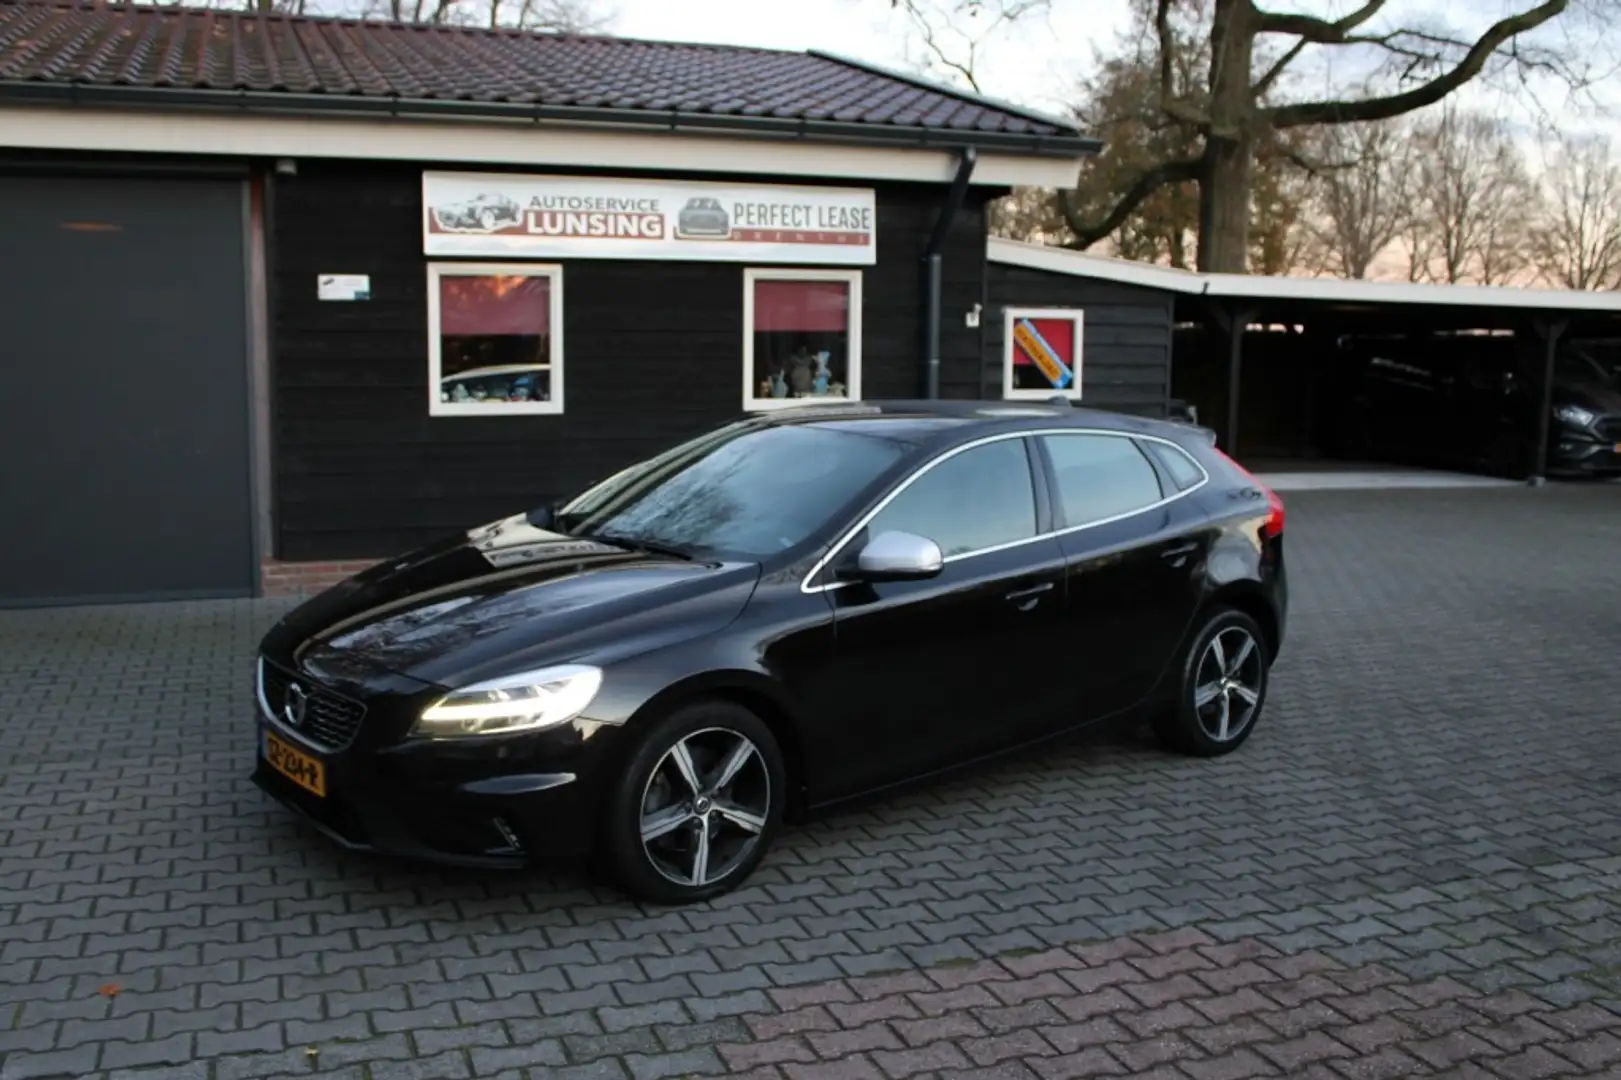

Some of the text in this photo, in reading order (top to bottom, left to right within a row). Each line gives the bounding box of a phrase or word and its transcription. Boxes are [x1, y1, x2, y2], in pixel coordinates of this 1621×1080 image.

[529, 196, 660, 212] AUTOSERVICE
[733, 202, 871, 230] PERFECT LEASE
[527, 211, 662, 237] LUNSING
